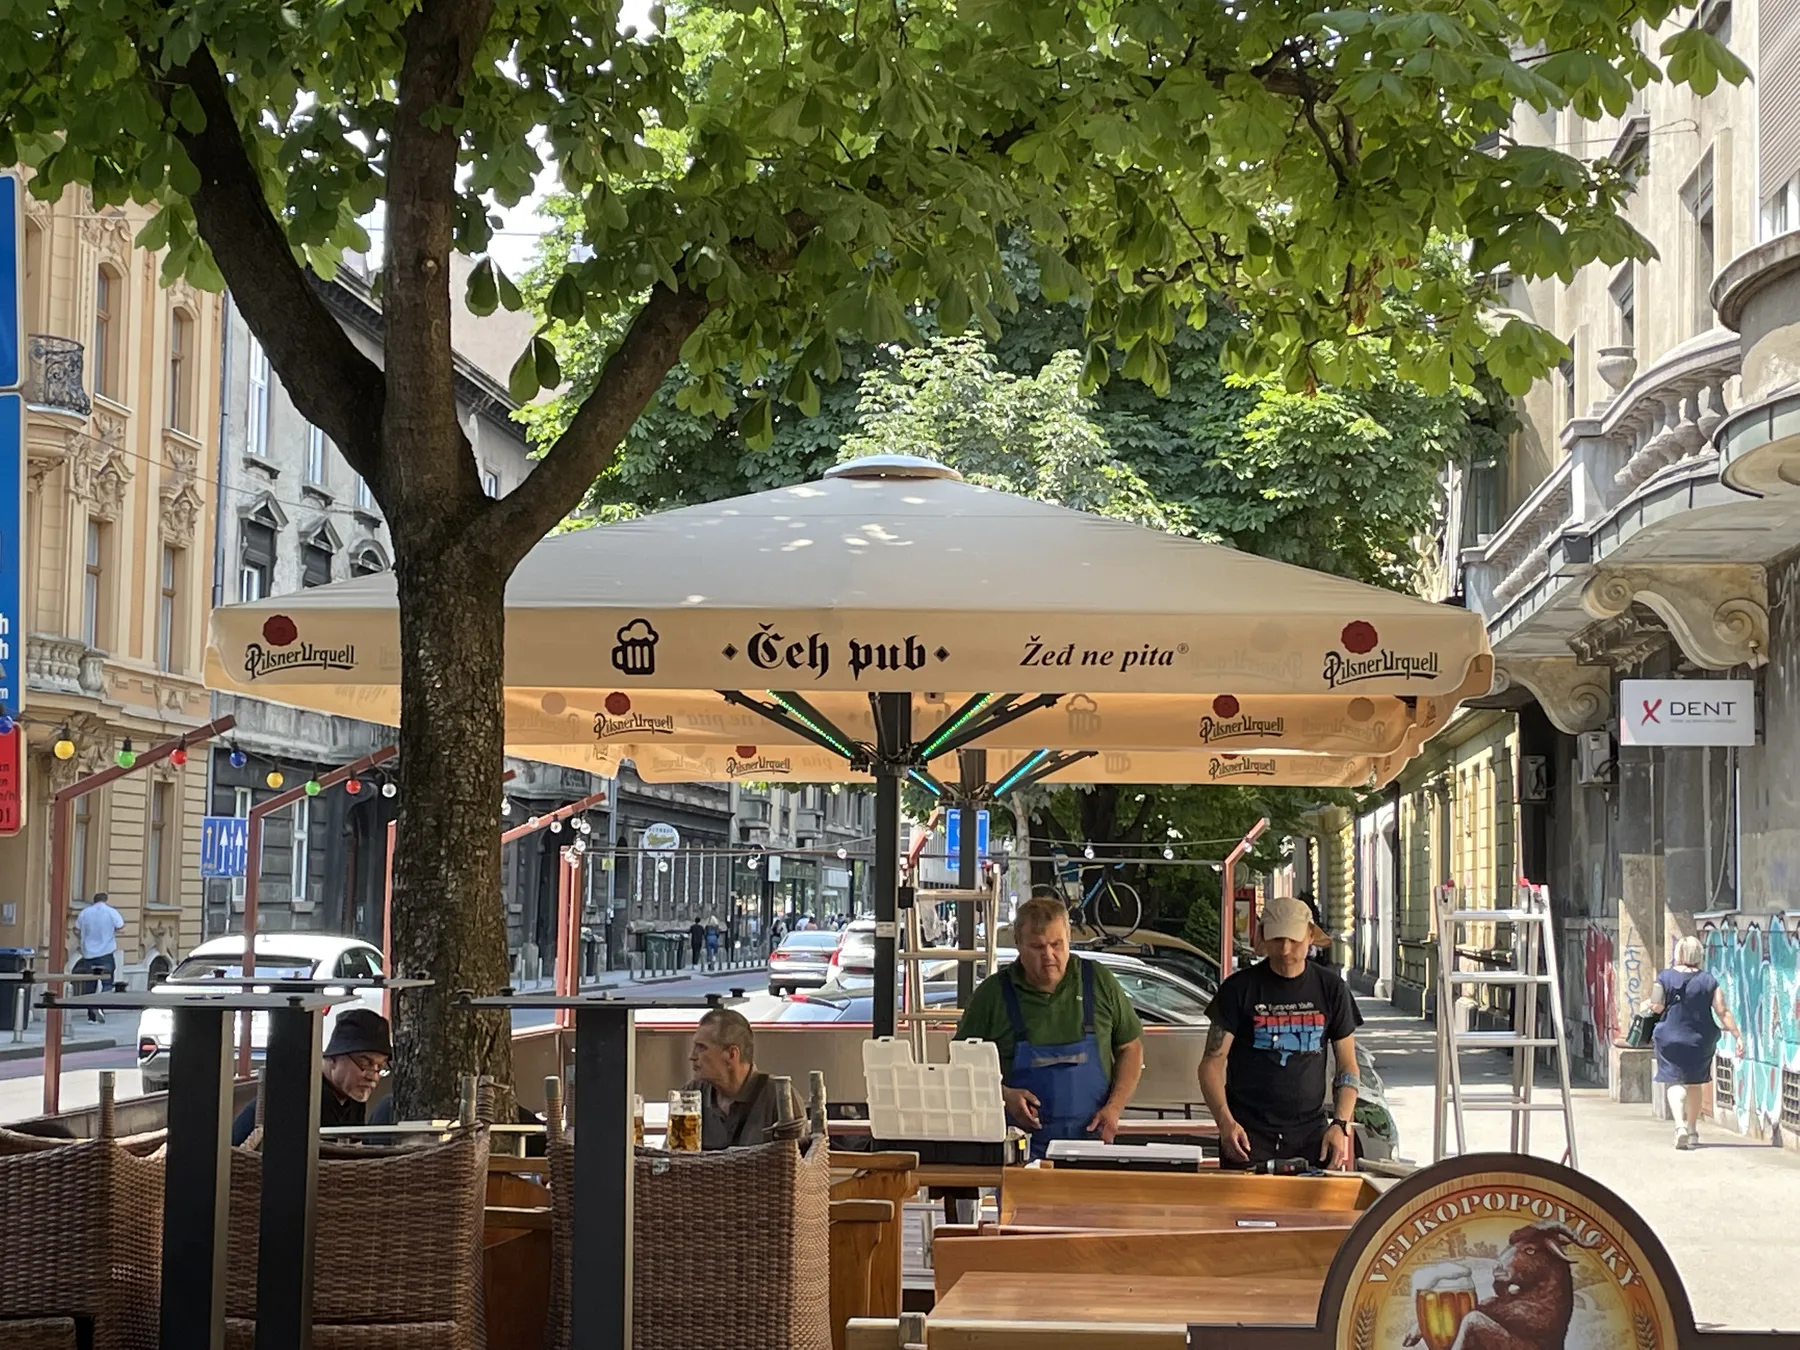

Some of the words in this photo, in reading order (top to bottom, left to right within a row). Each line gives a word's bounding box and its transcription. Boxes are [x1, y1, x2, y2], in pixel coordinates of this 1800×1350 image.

[244, 642, 302, 681] Pilsner
[300, 641, 354, 671] Urquell
[747, 622, 829, 681] Čeh
[848, 634, 926, 681] pub
[1019, 635, 1076, 666] Žeđ
[1081, 650, 1114, 666] ne
[1323, 650, 1382, 690] Pilsner
[1380, 648, 1438, 680] Urquell
[1669, 701, 1737, 716] DENT
[593, 712, 634, 740] Pilsner
[632, 712, 674, 735] Urquell
[1199, 716, 1243, 744] Pilsner
[1241, 715, 1284, 737] Urquell
[1208, 758, 1243, 781] Pilsner
[1241, 757, 1276, 776] Urquell
